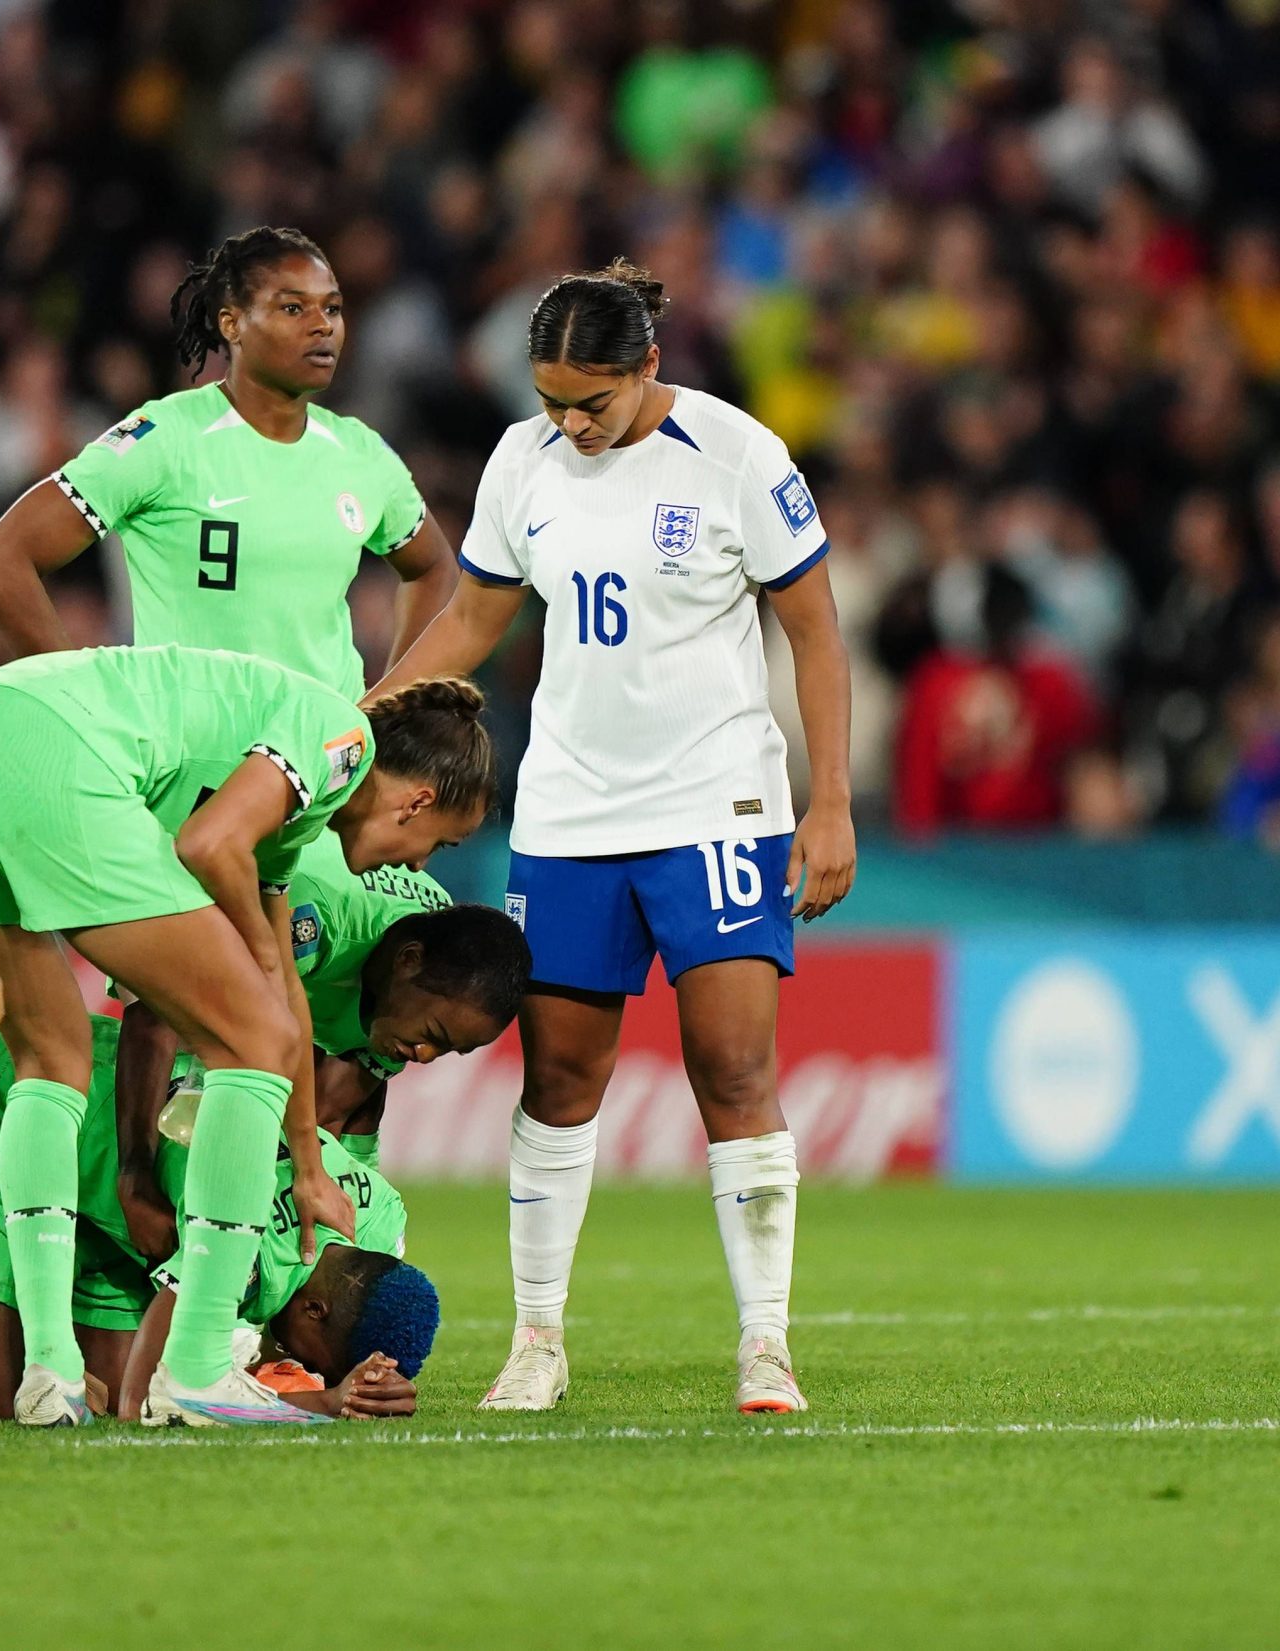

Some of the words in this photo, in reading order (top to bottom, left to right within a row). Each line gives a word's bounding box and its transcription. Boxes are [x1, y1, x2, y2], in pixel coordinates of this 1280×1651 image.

[198, 519, 239, 591] 9
[571, 570, 628, 647] 16
[697, 838, 763, 911] 16
